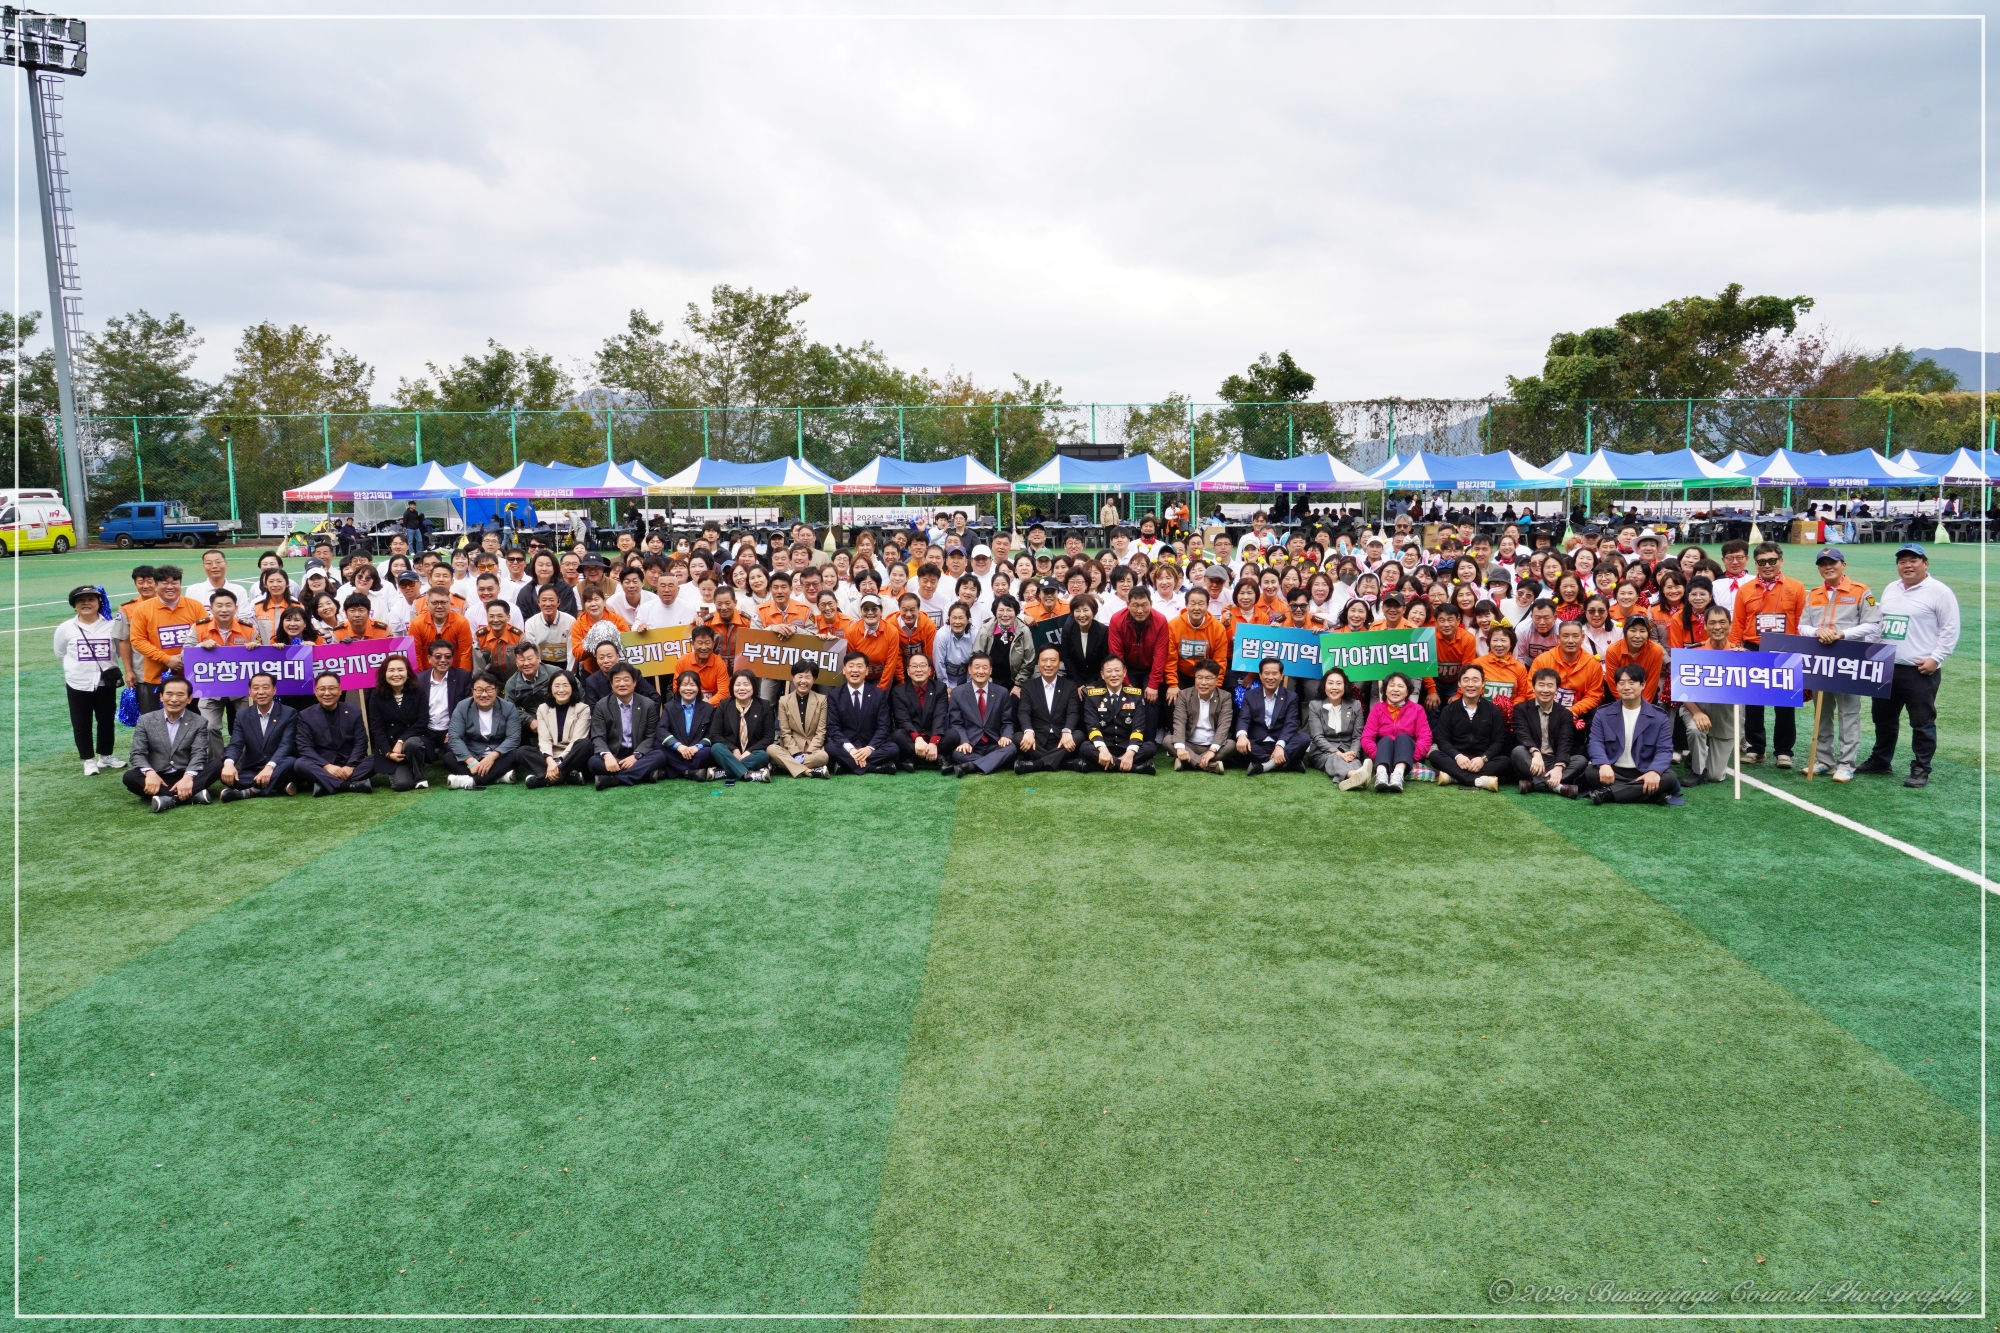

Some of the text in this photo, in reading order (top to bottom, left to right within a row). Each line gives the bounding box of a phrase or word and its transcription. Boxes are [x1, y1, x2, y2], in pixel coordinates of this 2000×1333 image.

[1456, 480, 1496, 489] 범일지역대
[1828, 478, 1869, 486] 당감지역대
[353, 491, 393, 500] 안창지역대
[534, 488, 574, 497] 부암지역대
[717, 487, 756, 495] 수정지역대
[902, 486, 942, 494] 부전지역대
[49, 510, 60, 518] 119
[1881, 620, 1907, 635] 가야
[159, 628, 190, 646] 안창
[78, 643, 110, 658] 안창
[742, 642, 839, 672] 부전지역대
[1241, 638, 1322, 665] 범일지역
[1328, 641, 1430, 668] 가야지역대
[193, 660, 305, 683] 안창지역대
[312, 650, 408, 678] 부암지역
[1679, 663, 1794, 690] 당감지역대
